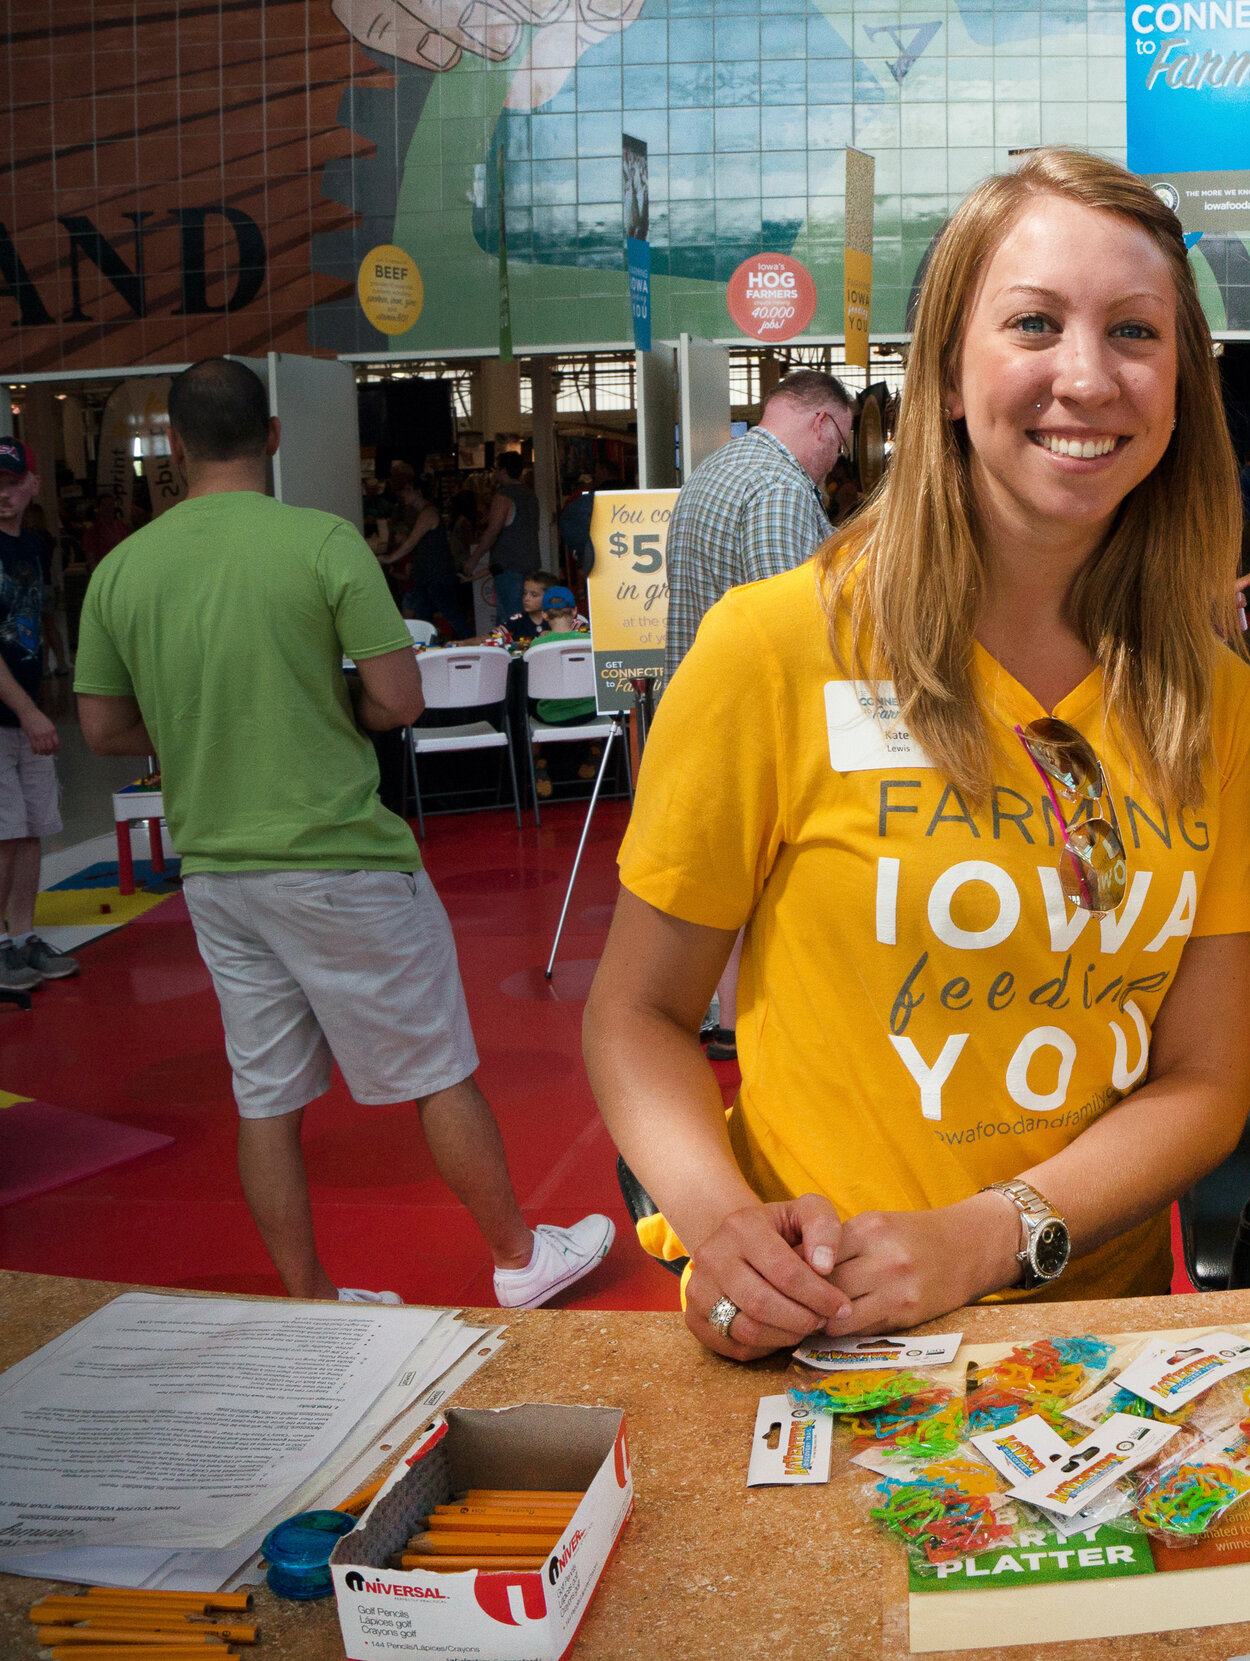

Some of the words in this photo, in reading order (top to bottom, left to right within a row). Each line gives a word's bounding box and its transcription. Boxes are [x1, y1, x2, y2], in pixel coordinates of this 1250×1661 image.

[1136, 39, 1156, 55] to
[1186, 190, 1200, 198] THE
[1224, 189, 1237, 197] WE
[375, 264, 409, 280] BEEF
[757, 263, 786, 271] Iowa's
[748, 271, 796, 289] HOG
[746, 289, 798, 299] FARMERS
[847, 290, 870, 305] IOWA
[757, 319, 786, 334] jobs!
[848, 315, 868, 333] YOU
[610, 504, 645, 524] You
[617, 582, 640, 601] in
[622, 617, 635, 628] at
[638, 616, 659, 628] the
[640, 632, 653, 644] of
[605, 661, 624, 669] GET
[606, 680, 615, 688] to
[885, 731, 909, 740] Kate
[889, 1000, 1150, 1121] YOU
[937, 1545, 1137, 1579] PLATTER
[357, 1604, 376, 1616] Golf
[377, 1607, 410, 1619] Pencils
[360, 1615, 396, 1629] Lápices
[397, 1619, 412, 1630] golf
[361, 1625, 399, 1639] Crayons
[400, 1629, 417, 1639] golf
[371, 1640, 385, 1648] 144
